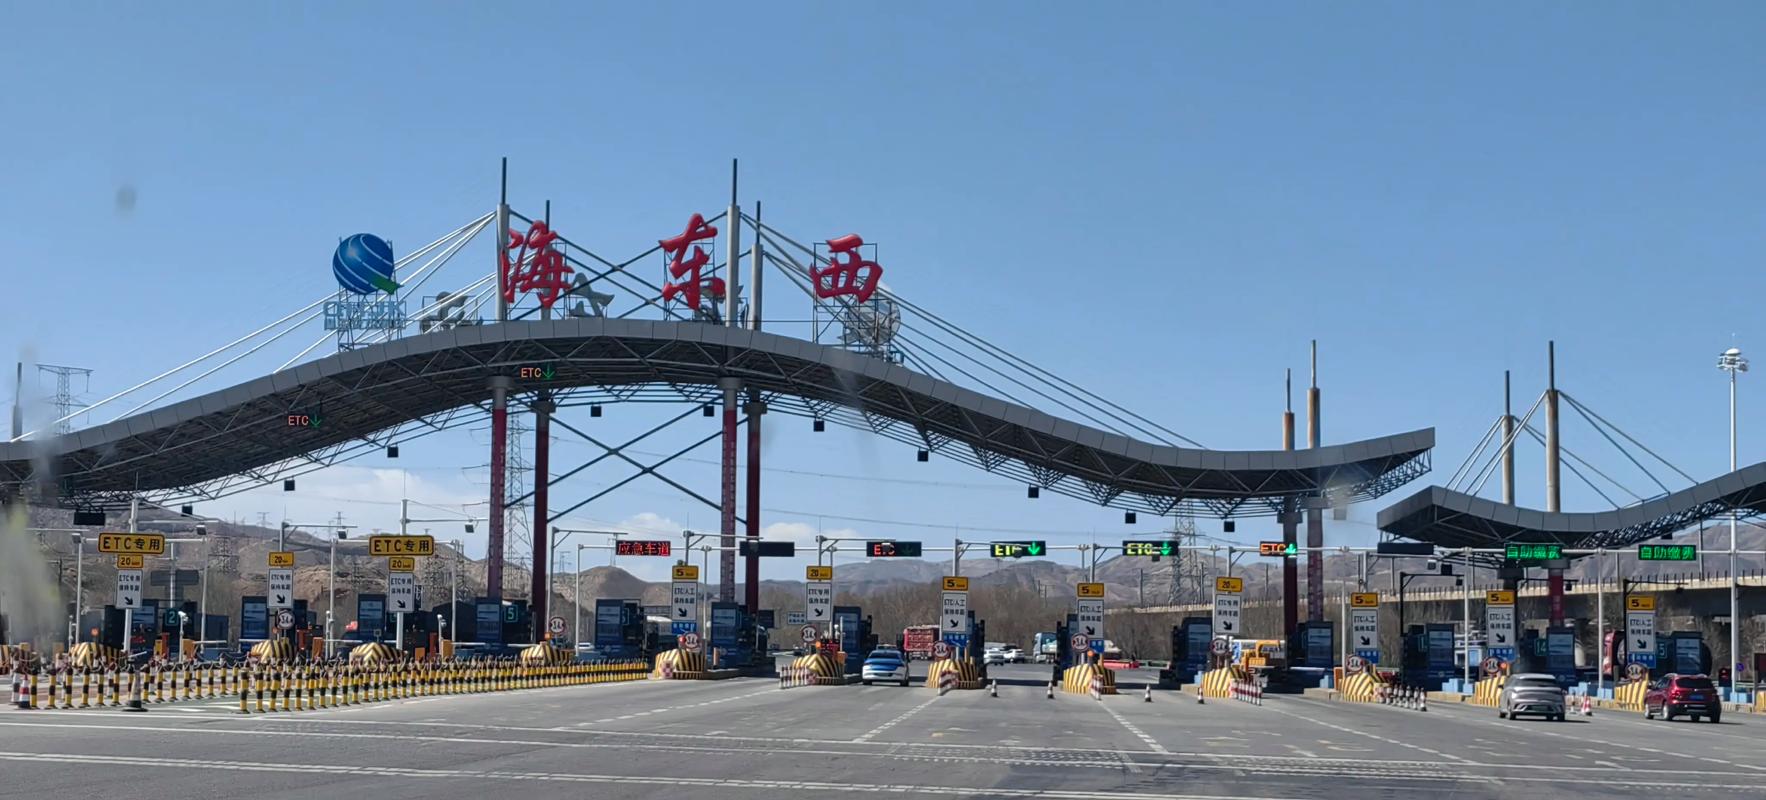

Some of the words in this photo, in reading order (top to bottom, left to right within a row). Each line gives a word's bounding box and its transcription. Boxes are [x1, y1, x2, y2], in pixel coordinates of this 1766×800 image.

[520, 367, 541, 378] ETC
[288, 415, 309, 426] ETC
[103, 536, 161, 550] ETC专用
[373, 539, 430, 553] ETC专用
[617, 541, 670, 556] 应急车道
[120, 557, 131, 566] 20
[391, 559, 402, 568] 20
[168, 611, 176, 623] 2
[507, 607, 515, 620] 5
